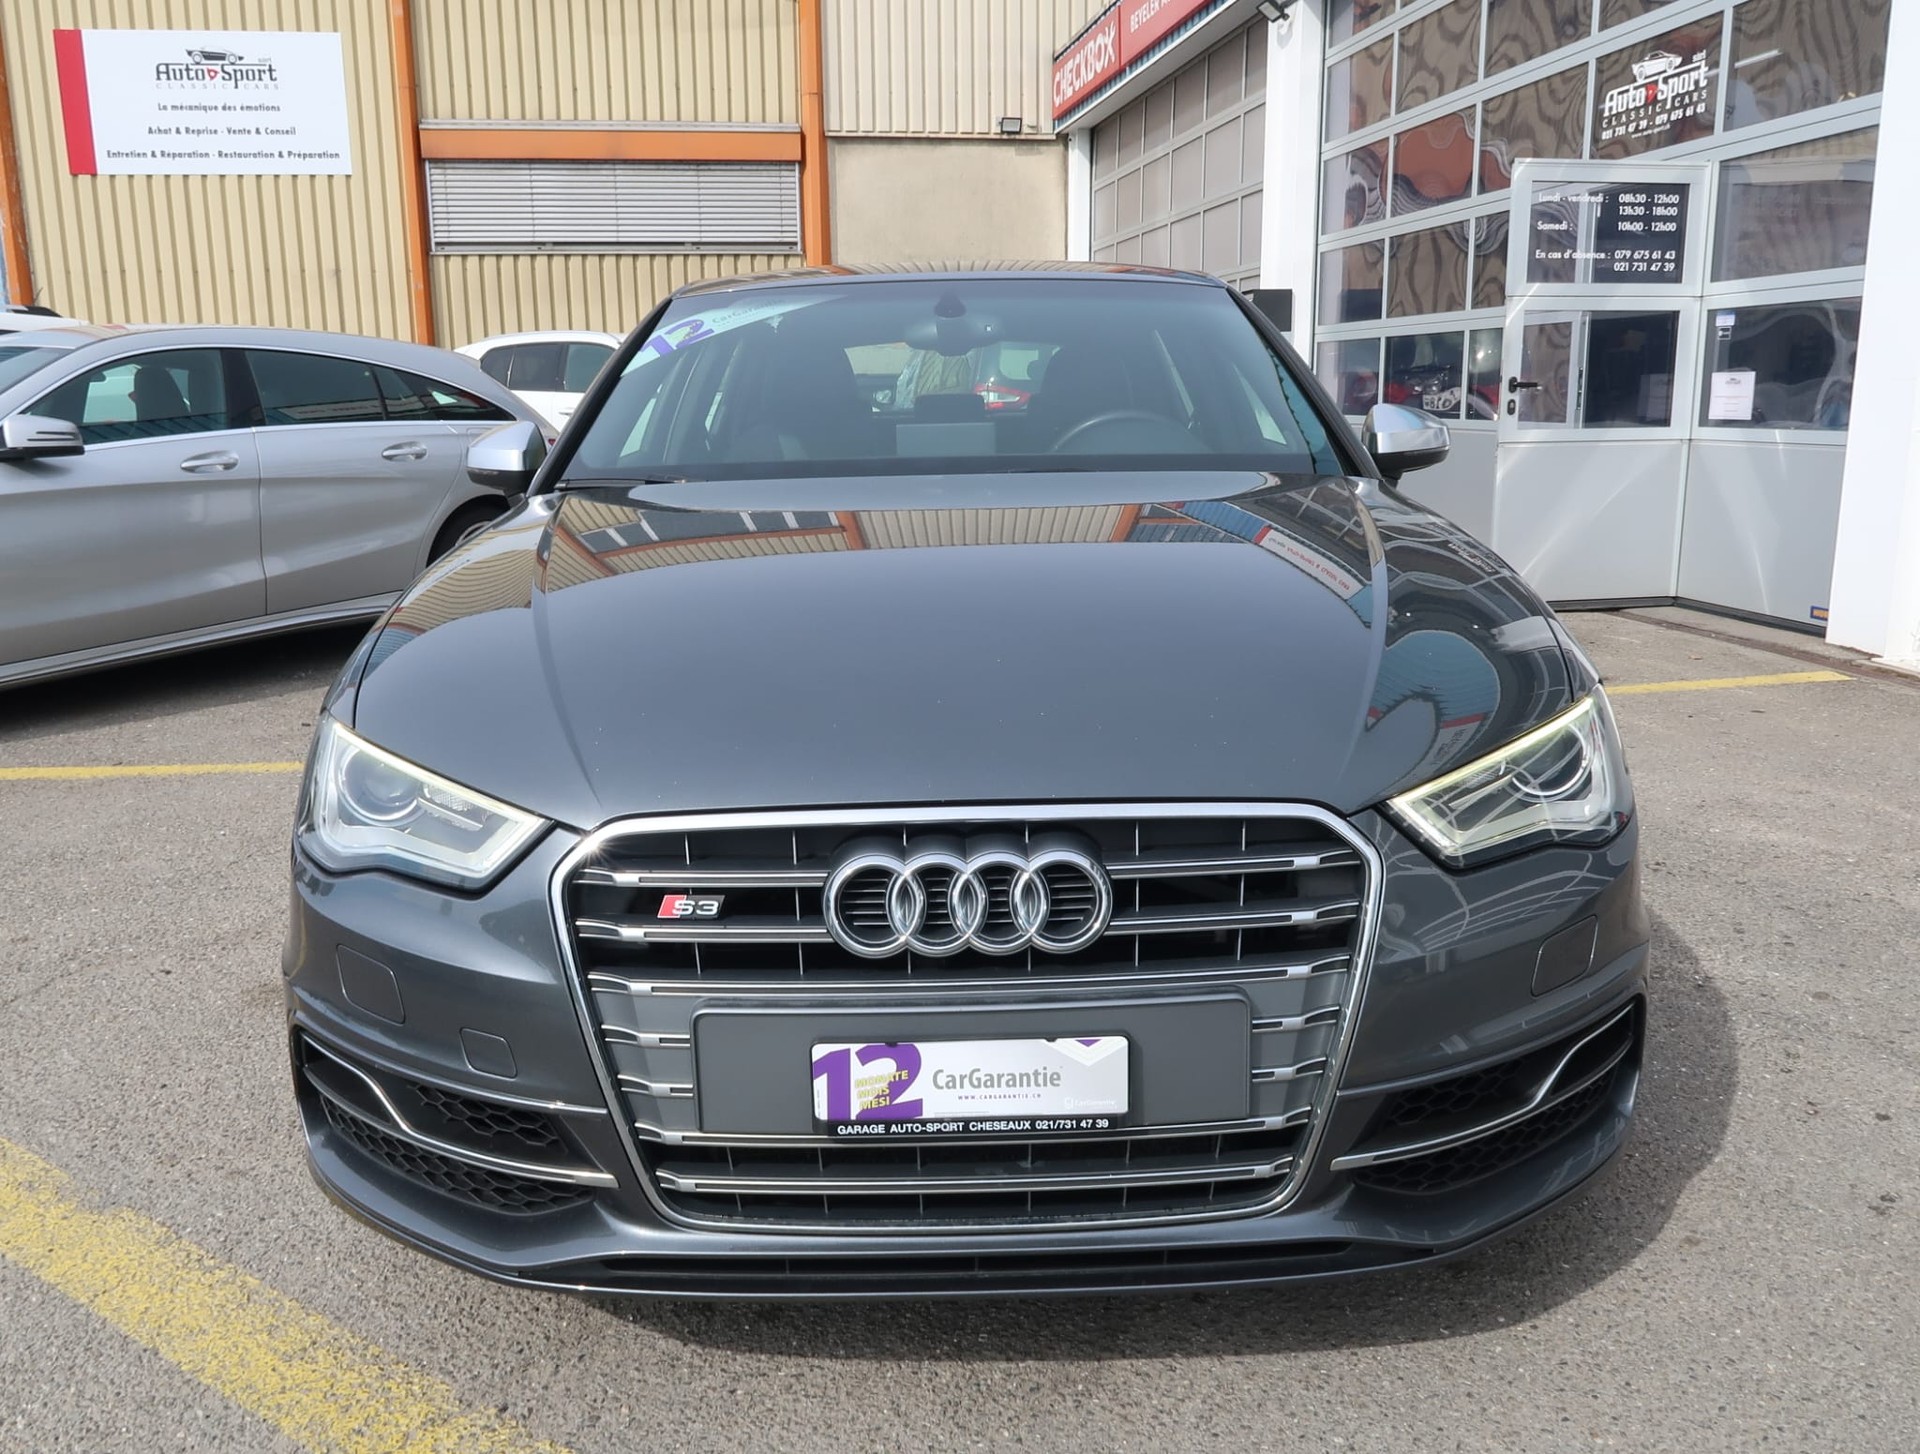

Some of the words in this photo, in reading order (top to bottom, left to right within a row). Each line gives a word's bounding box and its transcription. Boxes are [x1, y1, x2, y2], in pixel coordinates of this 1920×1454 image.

[1053, 21, 1116, 107] CHECKBOX
[156, 62, 206, 81] Auto
[221, 63, 278, 89] Sport
[1603, 84, 1646, 117] Auto
[1657, 60, 1709, 109] Sport
[158, 102, 168, 111] La
[171, 102, 219, 114] mécanique
[221, 102, 237, 111] des
[240, 102, 281, 112] émotions
[1602, 103, 1663, 128] CLASSIC
[1674, 89, 1708, 107] CARS
[148, 126, 172, 135] Achat
[175, 126, 181, 135] &
[185, 126, 218, 137] Reprise
[226, 126, 251, 135] Vente
[255, 127, 261, 135] &
[264, 126, 296, 135] Conseil
[106, 149, 148, 159] Entretien
[151, 150, 157, 158] &
[160, 149, 210, 160] Réparation
[218, 150, 275, 159] Restauration
[278, 150, 284, 159] &
[287, 150, 340, 161] Préparation
[1618, 193, 1646, 203] 08h30
[1654, 193, 1680, 204] 12h00
[1619, 205, 1645, 215] 13h30
[1652, 206, 1678, 216] 18h00
[1537, 220, 1568, 231] Samedi
[1618, 221, 1644, 231] 10h00
[1651, 221, 1677, 232] 12h00
[1535, 249, 1546, 259] En
[1547, 251, 1562, 259] cas
[1563, 248, 1606, 259] d'absence
[1614, 249, 1631, 259] 079
[1633, 249, 1650, 260] 675
[1651, 250, 1662, 260] 61
[1664, 250, 1676, 260] 43
[1613, 262, 1629, 272] 021
[1631, 262, 1647, 272] 731
[1650, 262, 1662, 272] 47
[1663, 262, 1675, 272] 39
[672, 900, 719, 915] S3
[813, 1044, 923, 1120] 12
[855, 1070, 909, 1088] MONATE
[933, 1066, 1062, 1090] CarGarantie
[857, 1085, 890, 1099] MOIS
[859, 1096, 890, 1110] MESI
[837, 1125, 886, 1135] GARAGE
[890, 1122, 965, 1134] AUTO-SPORT
[969, 1120, 1032, 1131] CHESEAUX
[1035, 1119, 1077, 1130] 021/731
[1080, 1119, 1094, 1129] 47
[1095, 1118, 1109, 1129] 39
